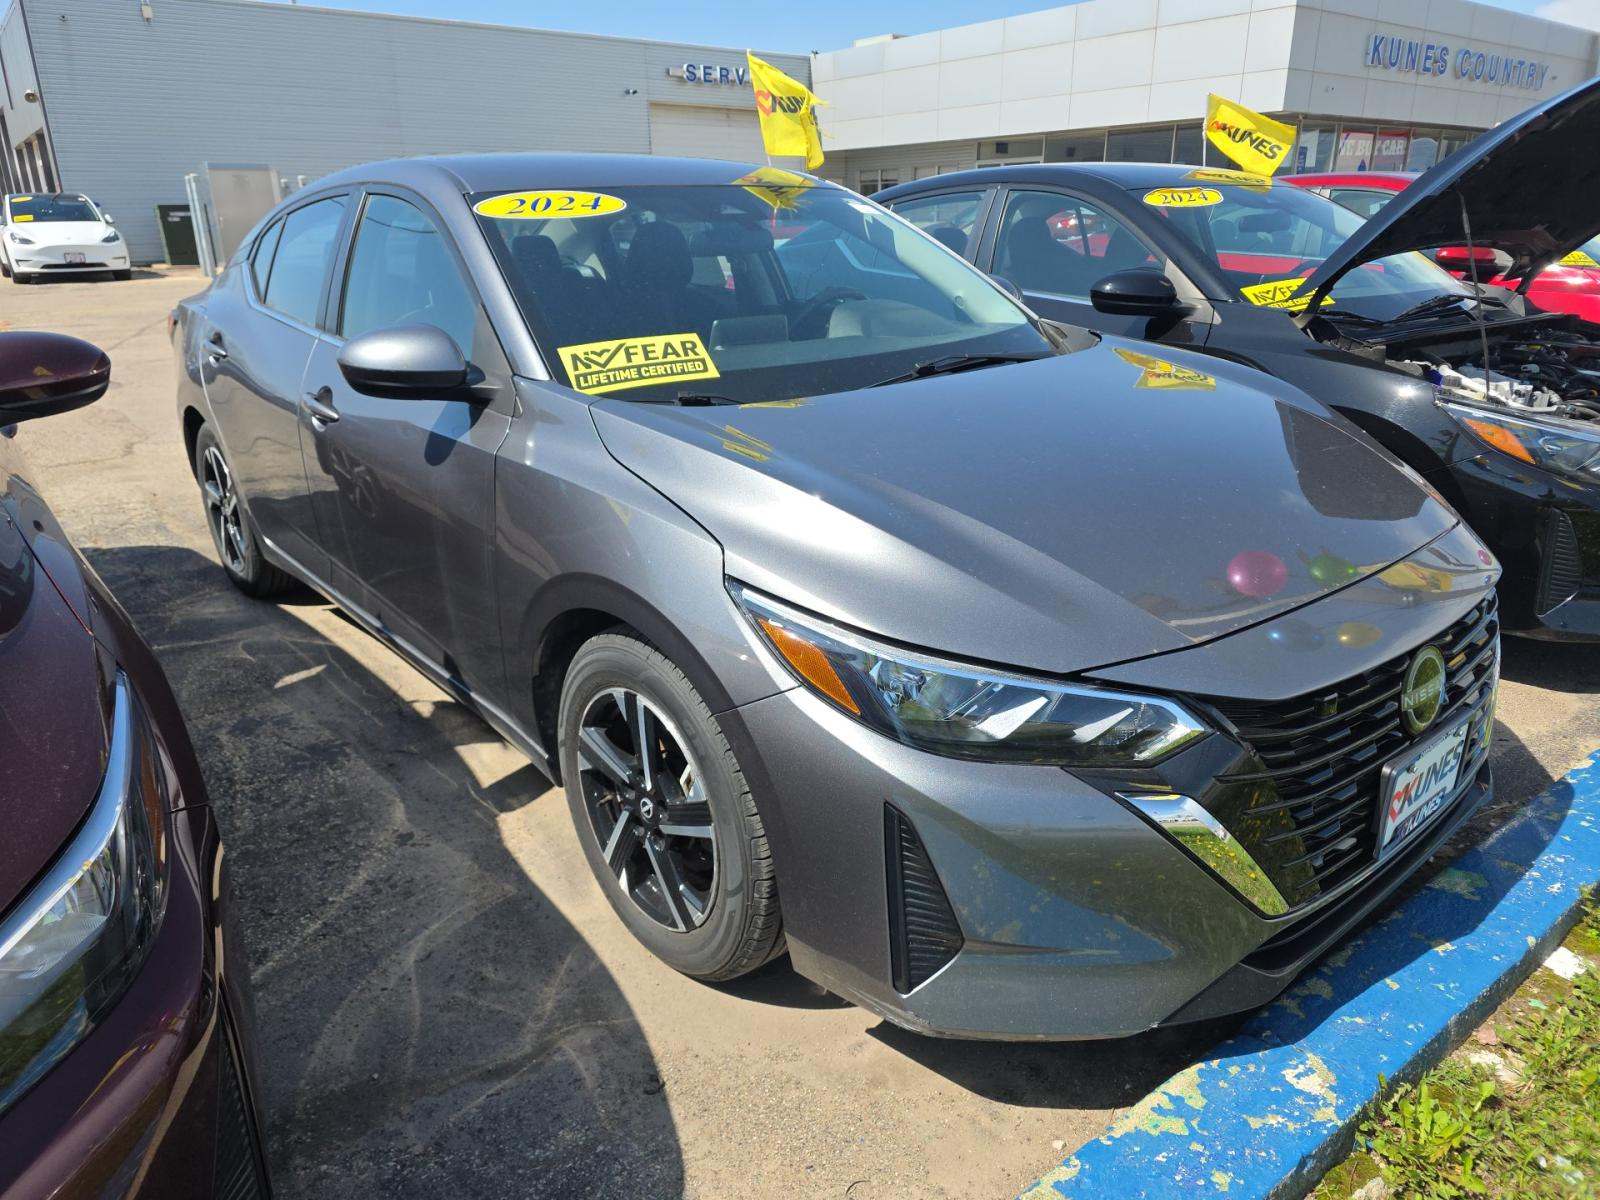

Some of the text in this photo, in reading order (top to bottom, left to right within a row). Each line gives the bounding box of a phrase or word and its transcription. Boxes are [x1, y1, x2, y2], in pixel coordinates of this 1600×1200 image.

[1368, 33, 1549, 91] KUNES COUNTRY
[683, 63, 747, 86] SERV
[505, 195, 602, 215] 2024
[1160, 191, 1208, 205] 2024
[624, 340, 700, 364] FEAR
[579, 361, 705, 388] LIFETIME CERTIFIED
[1399, 739, 1465, 815] KUNES
